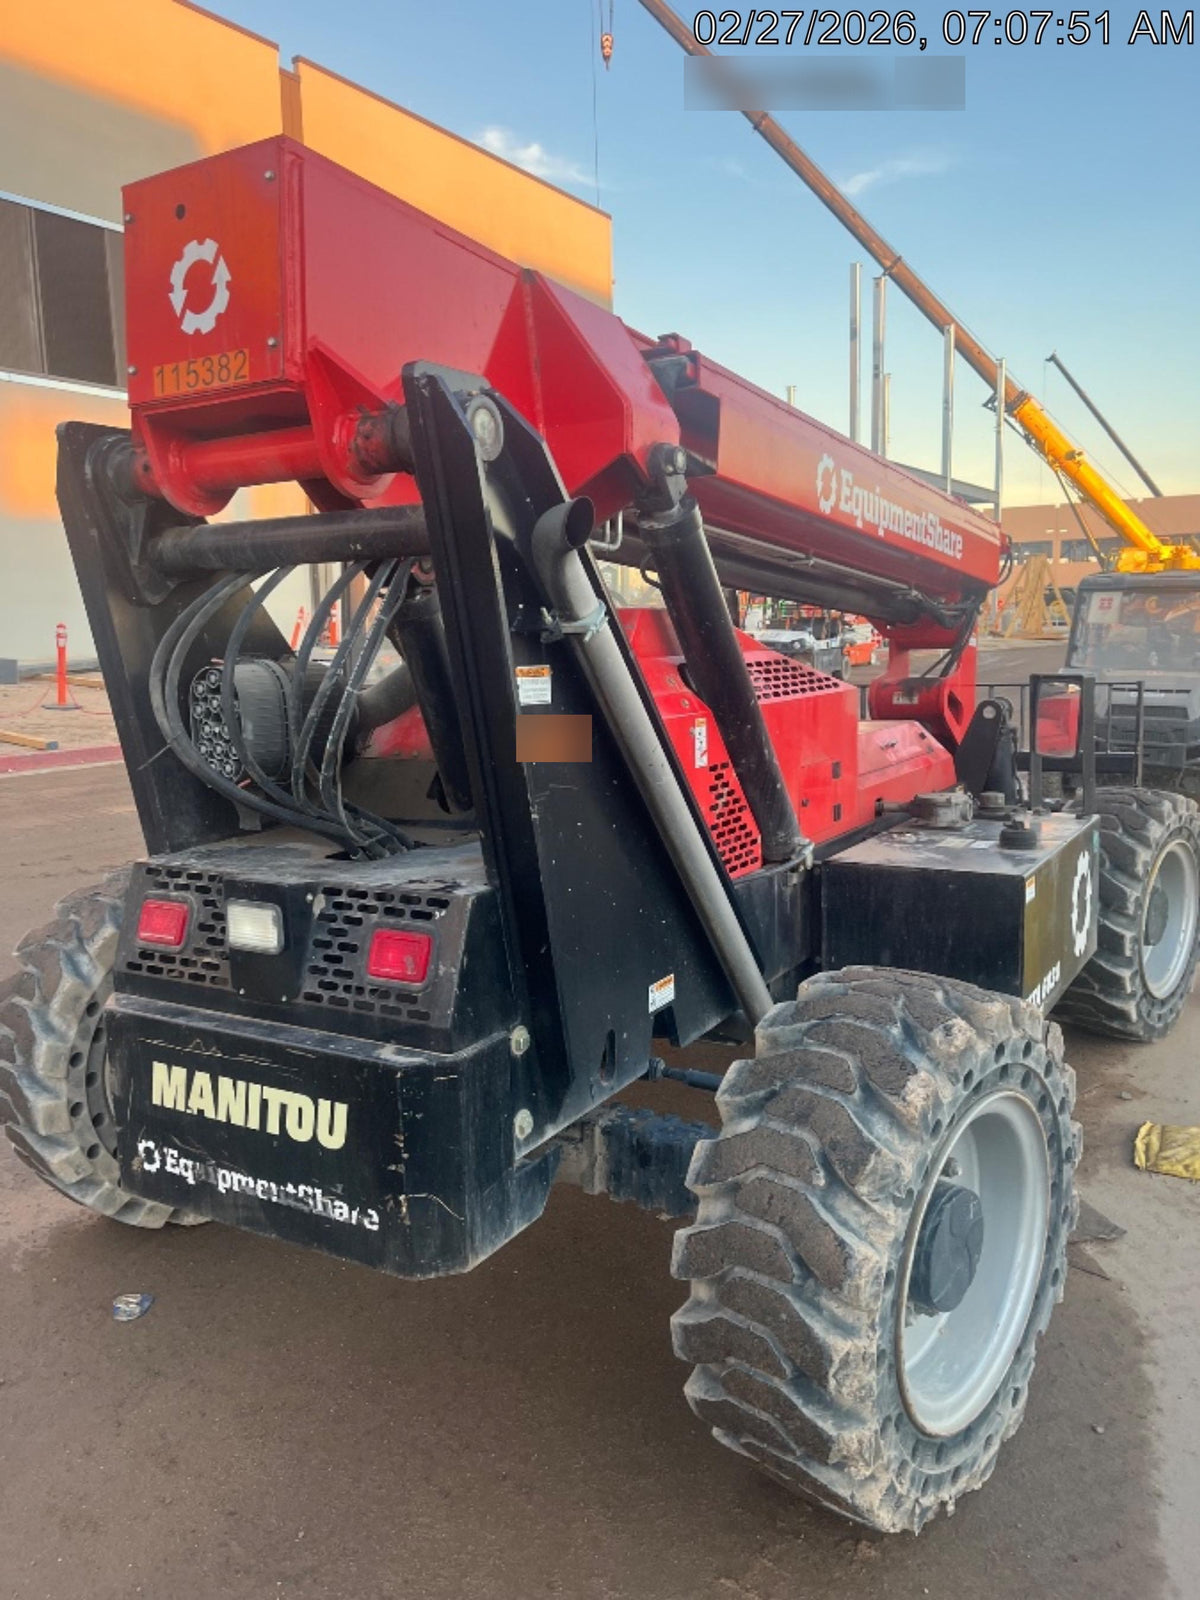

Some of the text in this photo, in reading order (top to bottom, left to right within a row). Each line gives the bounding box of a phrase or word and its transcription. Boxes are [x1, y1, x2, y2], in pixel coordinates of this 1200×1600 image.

[156, 350, 247, 393] 115382
[838, 468, 964, 561] EquipmentShare
[152, 1061, 349, 1150] MANITOU
[163, 1146, 379, 1231] EqpmentShare
